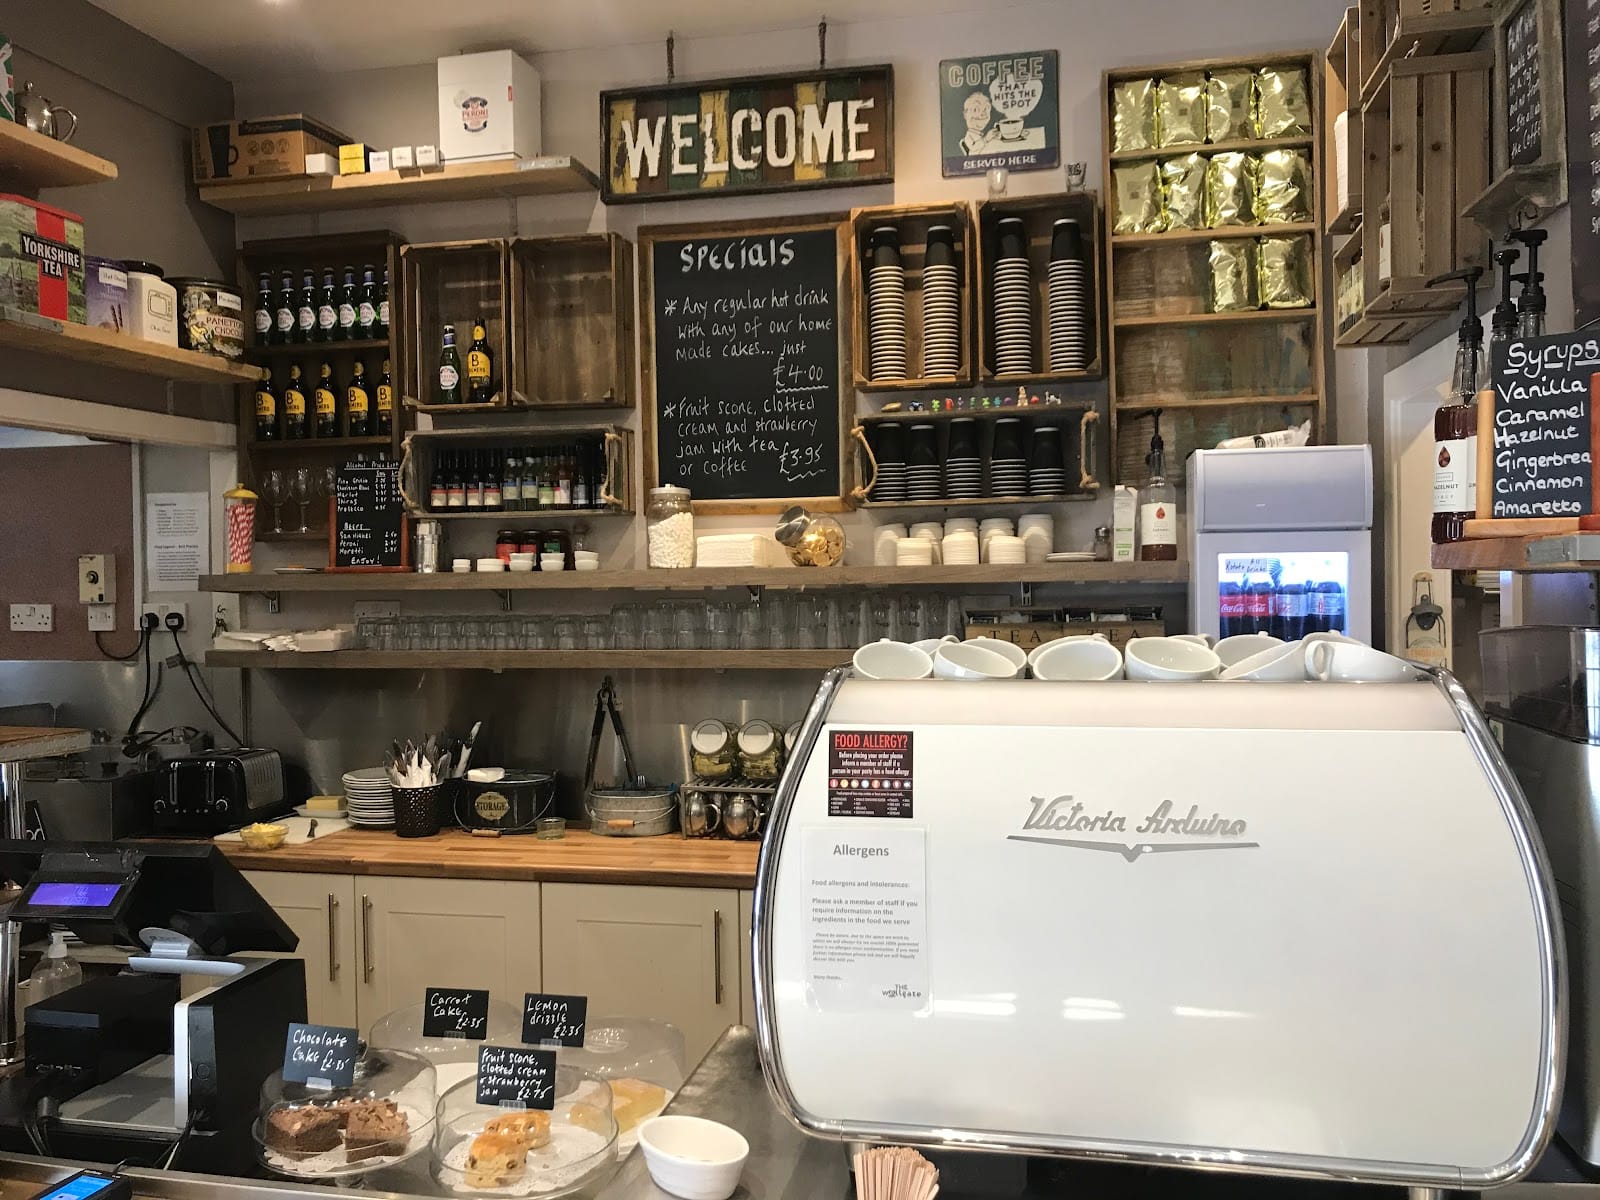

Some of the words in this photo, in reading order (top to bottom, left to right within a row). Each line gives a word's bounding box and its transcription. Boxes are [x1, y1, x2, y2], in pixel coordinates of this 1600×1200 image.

[949, 57, 1045, 88] COFFEE
[994, 91, 1015, 101] HITS
[1018, 89, 1037, 99] THE
[998, 82, 1027, 92] THAT
[1003, 99, 1031, 109] SPOT
[622, 98, 875, 178] WELCOME
[963, 157, 1006, 170] SERVED
[1008, 155, 1037, 166] HERE
[23, 236, 80, 268] YORKSHIRE
[43, 259, 62, 277] TEA
[682, 297, 708, 320] Any
[714, 288, 767, 318] regular
[771, 288, 789, 308] hot
[794, 284, 829, 306] drink
[678, 322, 705, 340] with
[712, 324, 736, 342] any
[744, 316, 762, 338] of
[769, 319, 794, 334] our
[799, 314, 832, 331] home
[780, 339, 807, 357] just
[471, 353, 480, 367] B
[1507, 340, 1599, 378] Syrups
[350, 389, 357, 402] B
[380, 387, 387, 400] B
[1497, 376, 1588, 403] Vanilla
[679, 396, 709, 418] Fruit
[718, 401, 757, 416] scone,
[1496, 401, 1585, 427] Caramel
[678, 423, 718, 437] cream
[725, 418, 747, 434] and
[755, 415, 818, 437] strawberry
[1493, 425, 1580, 448] Hazelnut
[676, 441, 705, 458] jam
[712, 437, 743, 455] with
[749, 435, 780, 452] tea
[679, 463, 693, 476] or
[1496, 449, 1592, 478] Gingerbrea
[1496, 476, 1583, 494] Cinnamon
[1494, 500, 1582, 517] Amaretto
[989, 630, 1042, 643] TEA
[834, 734, 860, 748] FOOD
[863, 735, 908, 748] ALLERGY?
[1022, 795, 1127, 832] Victoria
[1136, 799, 1247, 836] Arduino
[833, 844, 889, 858] Allergens
[828, 880, 856, 888] allergens
[430, 993, 472, 1006] Carrot
[527, 997, 567, 1011] Lemon
[433, 1006, 462, 1016] Cake
[530, 1011, 566, 1025] drizzle
[293, 1029, 348, 1047] Chocolate
[293, 1046, 320, 1062] Cake
[481, 1048, 505, 1063] Fruit
[509, 1053, 538, 1065] scone,
[481, 1063, 514, 1075] clotted
[517, 1067, 546, 1077] cream
[488, 1075, 542, 1088] strawberry
[480, 1085, 498, 1096] jam
[517, 1085, 553, 1101] £2.75
